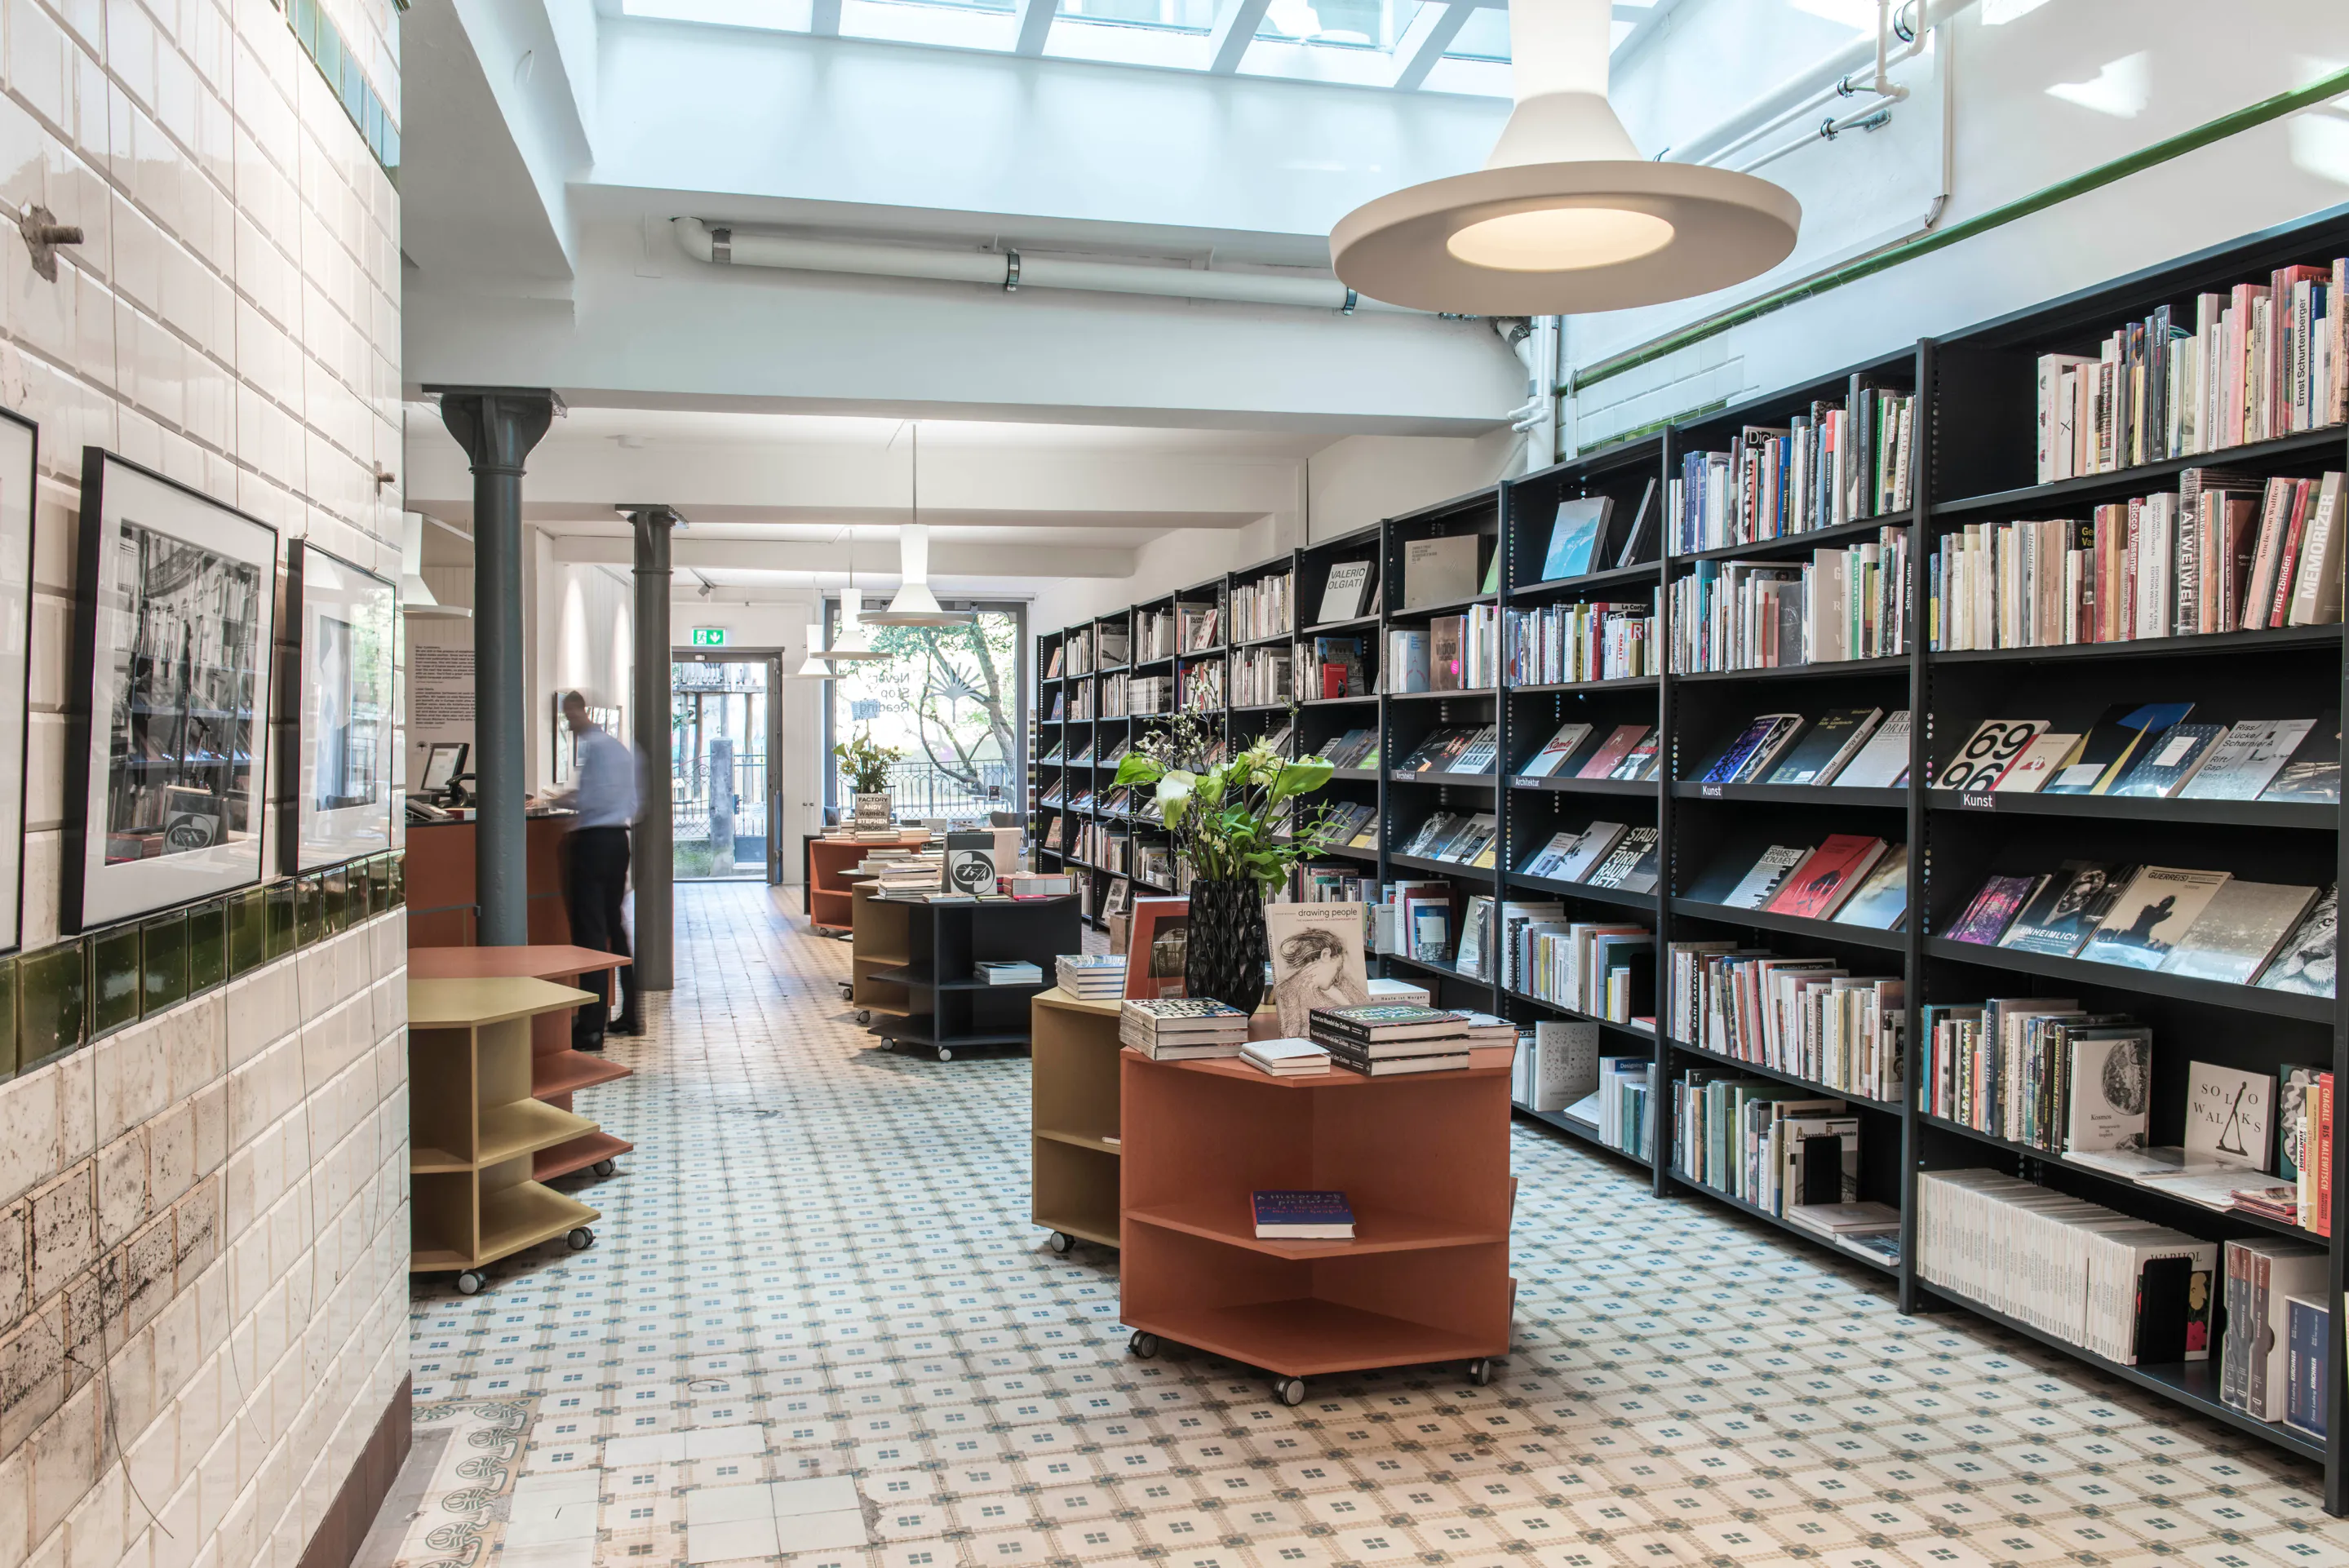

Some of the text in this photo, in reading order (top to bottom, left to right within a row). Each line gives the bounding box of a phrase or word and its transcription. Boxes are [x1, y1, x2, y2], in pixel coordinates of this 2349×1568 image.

[2297, 298, 2307, 407] Ernst Schurtenberger
[1897, 405, 1911, 503] MARTIN DISLER
[2260, 533, 2271, 560] Amelie
[2268, 485, 2280, 516] Wulffen
[2130, 503, 2139, 576] Ricco Wassmer
[2300, 494, 2334, 599] MEMORIZER
[2180, 512, 2194, 607] AI WEIWEI
[1331, 568, 1366, 579] VALERIO
[1327, 578, 1363, 590] OLGIATI
[2273, 555, 2292, 613] Fritz Zbinden
[1855, 729, 1864, 739] Eva
[2235, 724, 2263, 732] Riss/
[1966, 723, 2036, 760] 69
[2228, 732, 2263, 740] Lücke/
[2223, 740, 2266, 748] Scharnier
[2209, 755, 2235, 764] Rift/
[2203, 764, 2228, 773] Gap/
[1396, 772, 1416, 780] Architektur
[1515, 777, 1540, 787] Architektur
[1942, 761, 2004, 791] 96
[1701, 785, 1722, 797] Kunst
[1963, 793, 1993, 808] Kunst
[1607, 850, 1644, 866] FORM
[1596, 862, 1634, 879] RAUM
[2147, 870, 2190, 883] GUERRE(S)
[1298, 907, 1358, 919] drawing people
[2019, 926, 2080, 942] UNHEIMLICH
[1323, 1017, 1335, 1026] Wandel
[1339, 1022, 1350, 1031] Zeiten
[1323, 1034, 1334, 1042] Wandel
[1338, 1039, 1349, 1048] Zeiten
[1339, 1055, 1350, 1065] Zeiten
[2322, 1087, 2330, 1123] CHAGALL
[2194, 1101, 2262, 1133] WALKS
[1825, 1125, 1857, 1137] Rodchenko
[2322, 1124, 2330, 1139] BIS
[2320, 1139, 2331, 1191] MALEWITSCH
